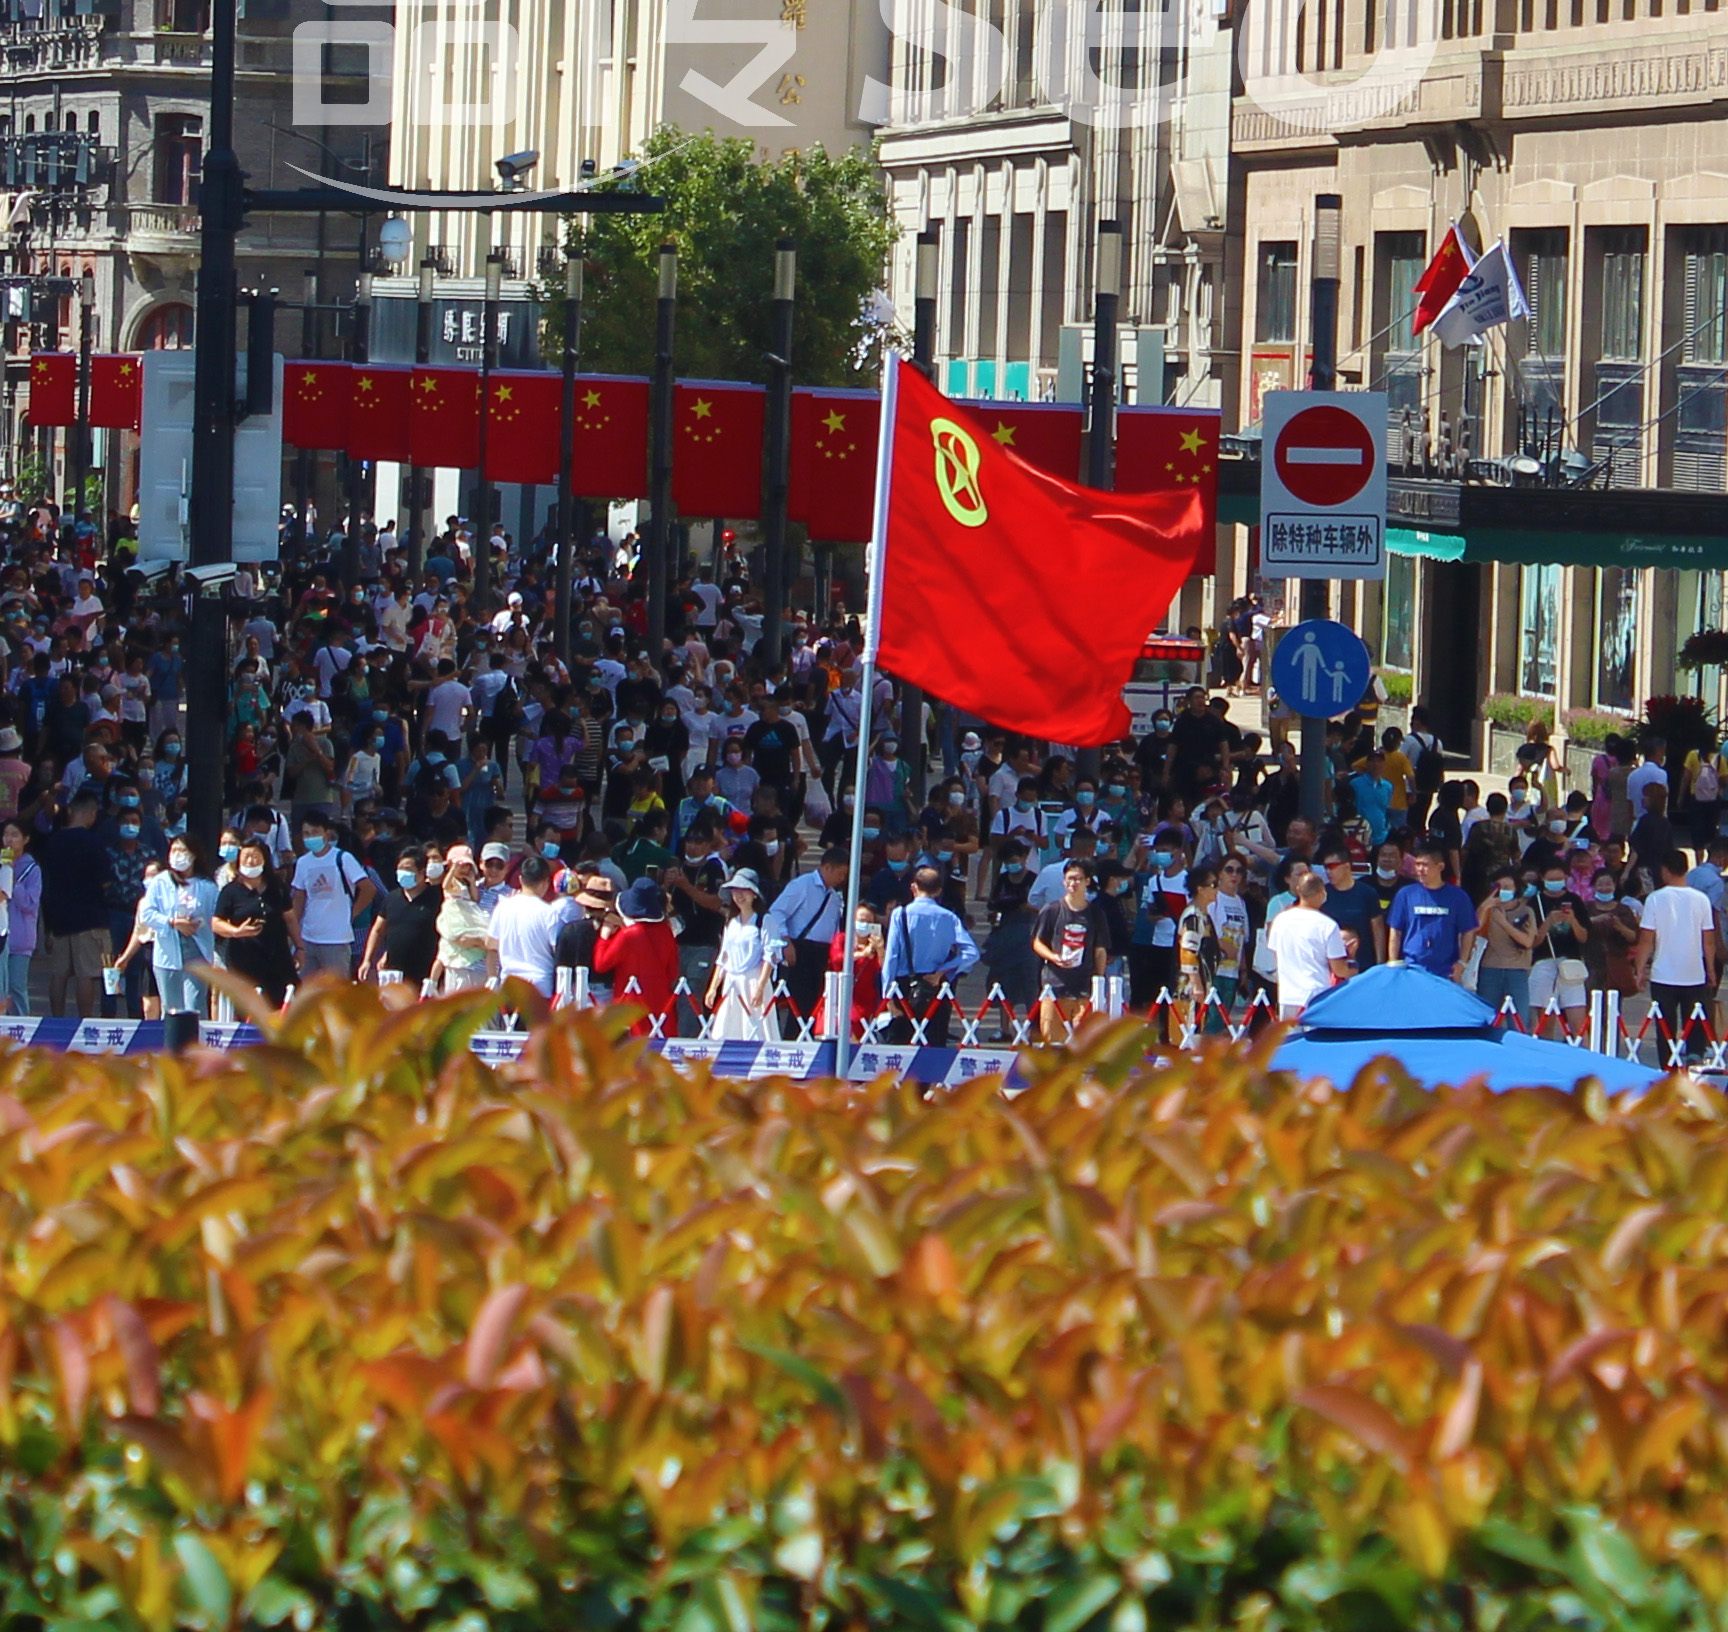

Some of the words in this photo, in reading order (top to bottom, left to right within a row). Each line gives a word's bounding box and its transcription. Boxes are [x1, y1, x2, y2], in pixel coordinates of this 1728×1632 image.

[1272, 522, 1373, 555] 除特种车辆外
[83, 1026, 124, 1046] 警戒
[206, 1029, 223, 1048] 戒
[471, 1038, 514, 1057] 警戒
[764, 1049, 805, 1069] 警戒
[861, 1052, 903, 1073] 警戒
[960, 1057, 1002, 1077] 警戒
